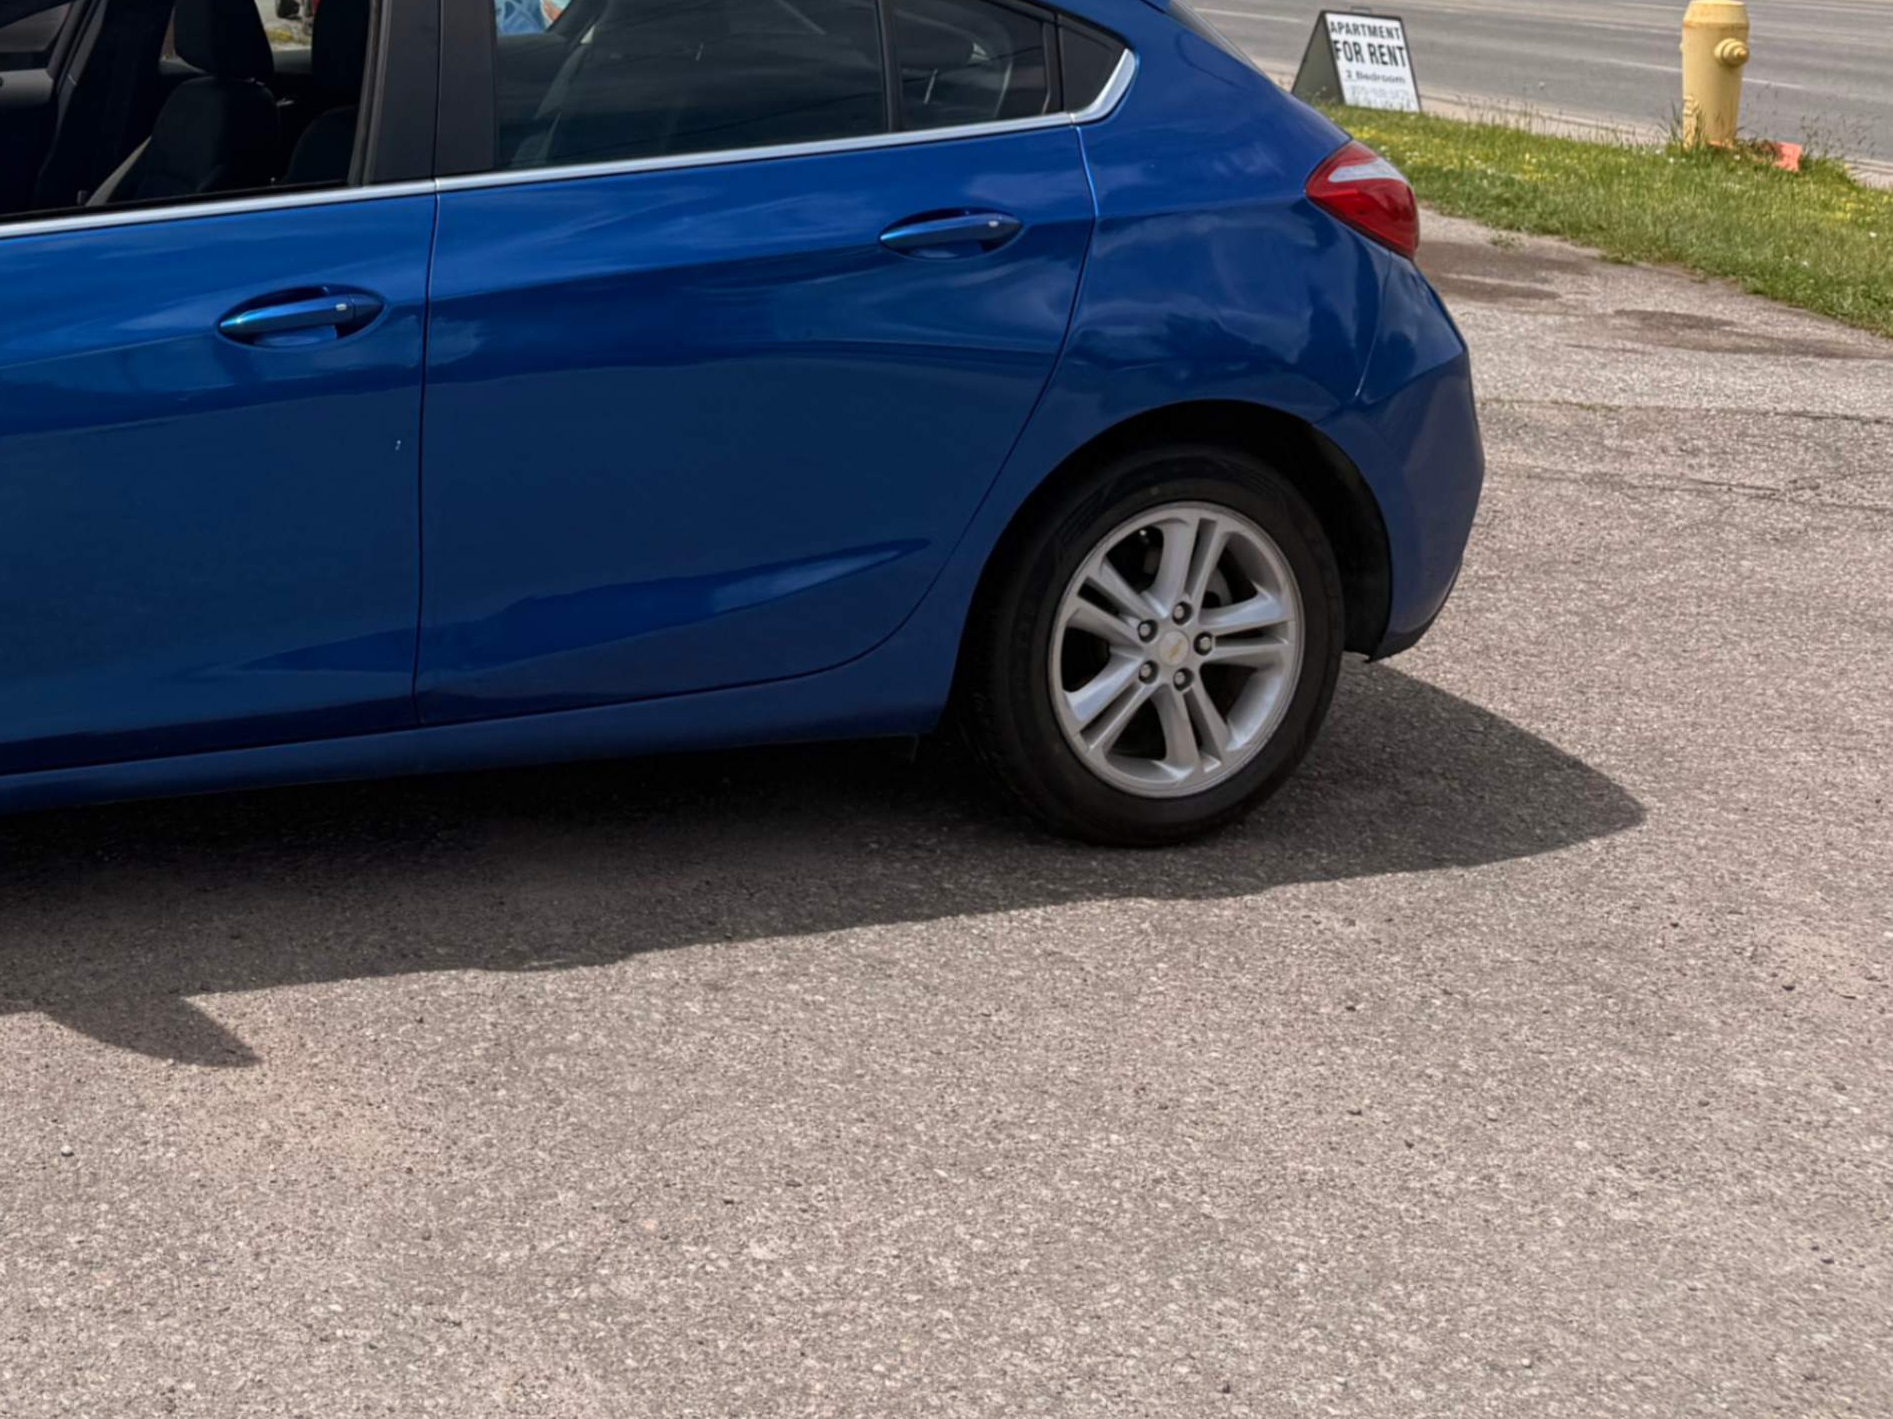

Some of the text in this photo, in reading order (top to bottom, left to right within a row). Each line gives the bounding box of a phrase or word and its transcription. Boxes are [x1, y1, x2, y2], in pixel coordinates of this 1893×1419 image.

[1330, 21, 1400, 40] APARTMENT
[1333, 40, 1406, 68] FOR RENT
